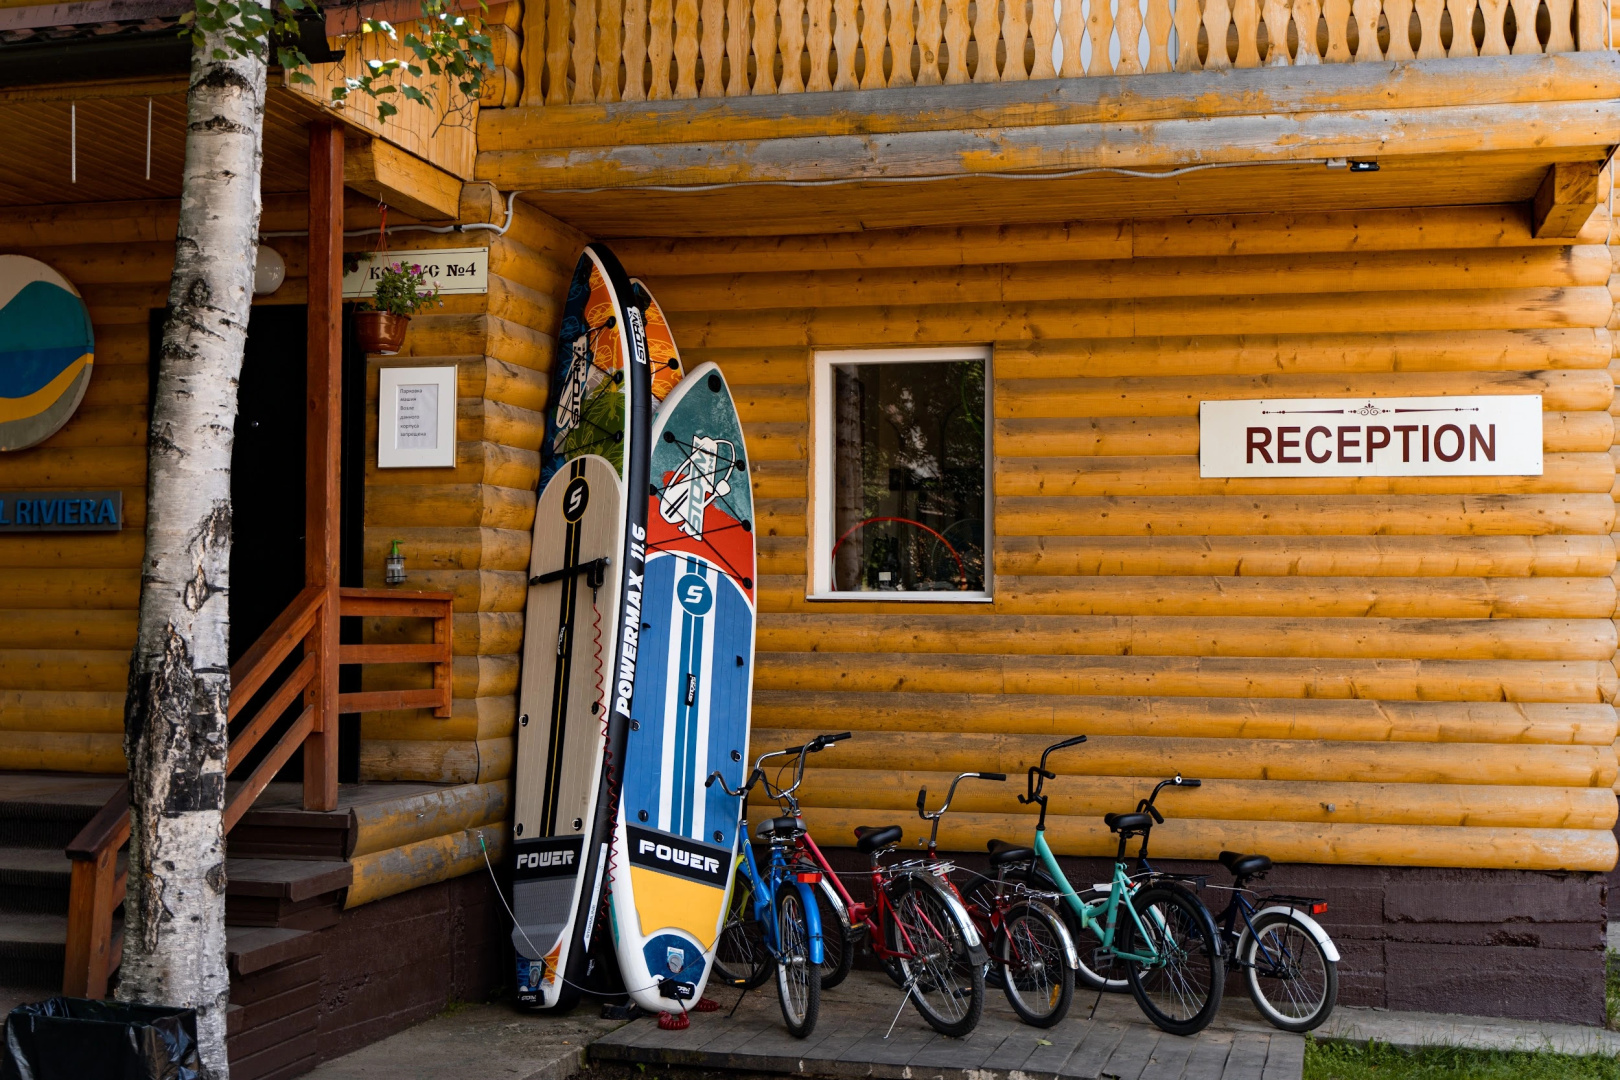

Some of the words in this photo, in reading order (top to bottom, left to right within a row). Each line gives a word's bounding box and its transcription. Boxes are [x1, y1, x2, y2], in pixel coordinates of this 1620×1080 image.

[629, 310, 645, 361] STORM
[571, 345, 581, 425] STORM
[1246, 423, 1496, 464] RECEPTION
[687, 441, 707, 534] STORM
[16, 498, 118, 525] RIVIERA
[615, 569, 644, 719] POWERMAX
[631, 523, 646, 563] 11.6
[516, 850, 575, 870] POWER
[639, 839, 720, 875] POWER
